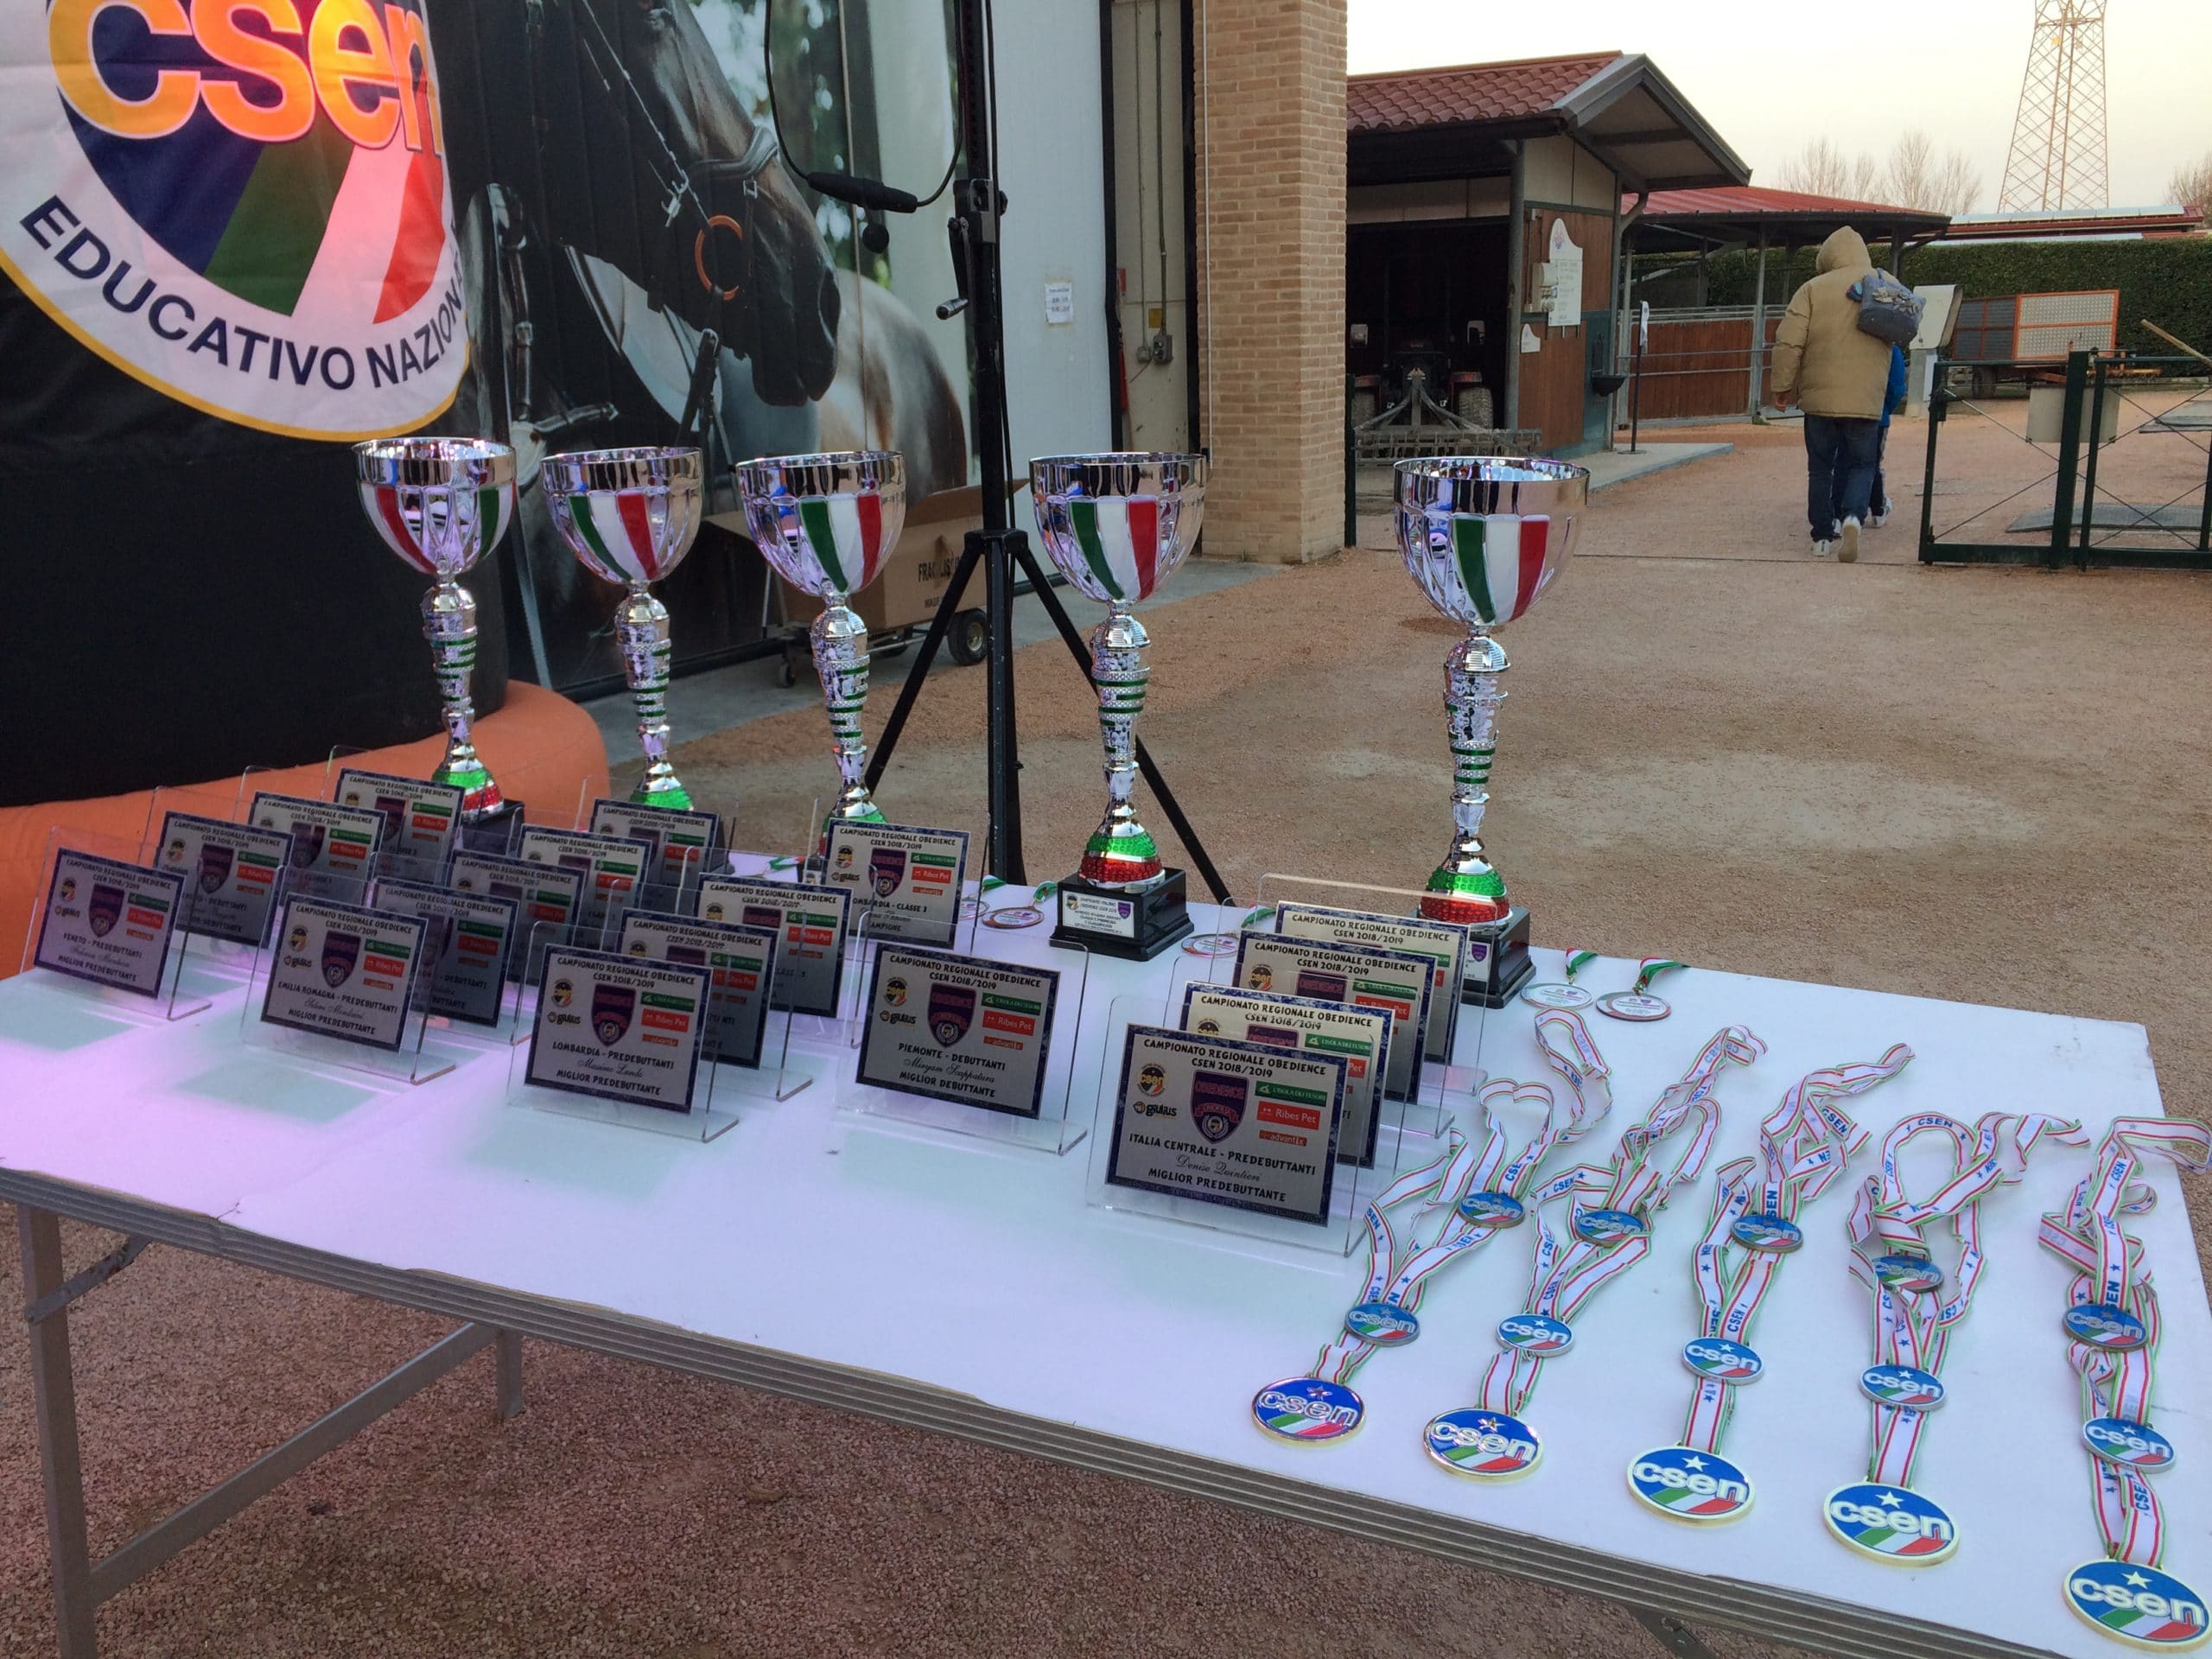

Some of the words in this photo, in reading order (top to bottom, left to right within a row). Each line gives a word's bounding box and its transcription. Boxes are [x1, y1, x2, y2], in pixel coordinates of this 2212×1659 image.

[48, 0, 445, 156] csen
[19, 194, 355, 390] EDUCATIVO
[840, 828, 880, 837] CAMPIONATO
[881, 832, 917, 842] REGIONALE
[919, 836, 956, 846] OBEDIENCE
[710, 884, 753, 894] CAMPIONATO
[755, 889, 795, 899] REGIONALE
[797, 893, 837, 904] OBEDIENCE
[853, 898, 890, 908] OMBRDIA
[897, 903, 920, 912] CLASSE
[296, 906, 336, 918] CAMPIONATO
[338, 913, 373, 927] REGIONALE
[375, 921, 411, 934] OBEDIENCE
[634, 920, 677, 933] CAMPIONATO
[680, 926, 718, 940] REGIONALE
[721, 933, 762, 945] OBEDIENCE
[870, 922, 901, 931] AMPIONE
[1293, 914, 1346, 928] CAMPIONATO
[1348, 921, 1396, 933] REGIONALE
[1400, 928, 1450, 942] OBEDIENCE
[63, 932, 86, 944] VENETO
[92, 940, 142, 958] PREDEBUTTANTI
[1333, 930, 1356, 938] CSEN
[1357, 931, 1403, 944] 2018/2019
[1255, 942, 1310, 957] CAMPIONATO
[1313, 950, 1362, 965] REGIONALE
[1365, 959, 1417, 973] OBEDIENCE
[1296, 958, 1319, 968] CSEN
[1320, 961, 1369, 976] 2018/2019
[86, 960, 137, 982] PREDEBUTTANTE
[557, 957, 604, 971] CAMPIONATO
[607, 964, 649, 978] REGIONALE
[652, 972, 695, 985] OBEDIENCE
[593, 973, 612, 982] CSEN
[613, 975, 655, 988] 2018/2019
[890, 955, 942, 970] CAMPIONATO
[944, 964, 990, 979] REGIONALE
[993, 972, 1041, 988] OBEDIENCE
[929, 972, 949, 982] CSEN
[951, 975, 997, 989] 2018/2019
[278, 982, 301, 993] EMILIA
[302, 986, 334, 1000] ROMAGNA
[341, 995, 397, 1014] PREDEBUTTANTI
[1201, 995, 1259, 1011] CAMPIONATO
[1262, 1004, 1314, 1019] REGIONALE
[1318, 1013, 1373, 1027] OBEDIENCE
[1394, 1004, 1408, 1014] Pet
[288, 1008, 316, 1021] MIGLIOR
[318, 1015, 376, 1034] PREDEBUTTANTE
[998, 1016, 1017, 1027] Ribes
[1020, 1020, 1032, 1030] Pet
[1245, 1014, 1268, 1023] CSEN
[1270, 1016, 1322, 1030] 2018/2019
[553, 1041, 600, 1057] LOMBARDIA
[608, 1051, 674, 1070] PREDEBUTTANTI
[899, 1043, 943, 1059] PIEMONTE
[951, 1053, 1006, 1071] DEBUTTANTI
[1143, 1039, 1206, 1057] CAMPIONATO
[1209, 1050, 1264, 1066] REGIONALE
[1268, 1058, 1326, 1076] OBEDIENCE
[1192, 1057, 1215, 1069] CSEN
[1217, 1060, 1273, 1077] 2018/2019
[1348, 1063, 1363, 1072] Pet
[556, 1070, 590, 1083] MIGLIOR
[593, 1076, 661, 1095] PREDEBUTTANTE
[899, 1071, 937, 1085] MIGLIOR
[939, 1078, 996, 1097] DEBUTTANTE
[1276, 1109, 1300, 1120] Ribes
[1301, 1113, 1316, 1123] Pet
[1821, 1108, 1848, 1134] CSEN
[1917, 1117, 1953, 1128] CSEN
[1129, 1133, 1160, 1147] ITALIA
[1164, 1139, 1217, 1157] CENTRALE
[1228, 1151, 1316, 1175] PREDEBUTTANTI
[1148, 1168, 1192, 1184] MIGLIOR
[1196, 1176, 1287, 1202] PREDEBUTTANTE
[1505, 1163, 1522, 1181] CSE
[1554, 1176, 1575, 1192] CSEN
[1766, 1191, 1777, 1218] SEN
[1366, 1208, 1381, 1230] SEN
[2106, 1281, 2120, 1308] SEN
[1348, 1310, 1416, 1334] csen
[1500, 1321, 1572, 1345] csen
[1727, 1310, 1745, 1332] CSEN
[2066, 1311, 2146, 1338] csen
[1686, 1344, 1759, 1371] csen
[1863, 1372, 1942, 1399] csen
[1258, 1390, 1359, 1427] csen
[1430, 1421, 1537, 1461] csen
[2085, 1426, 2171, 1459] csen
[1633, 1461, 1748, 1503] csen
[2134, 1482, 2151, 1510] CSE
[1829, 1500, 1952, 1541] csen
[2070, 1577, 2208, 1627] csen
